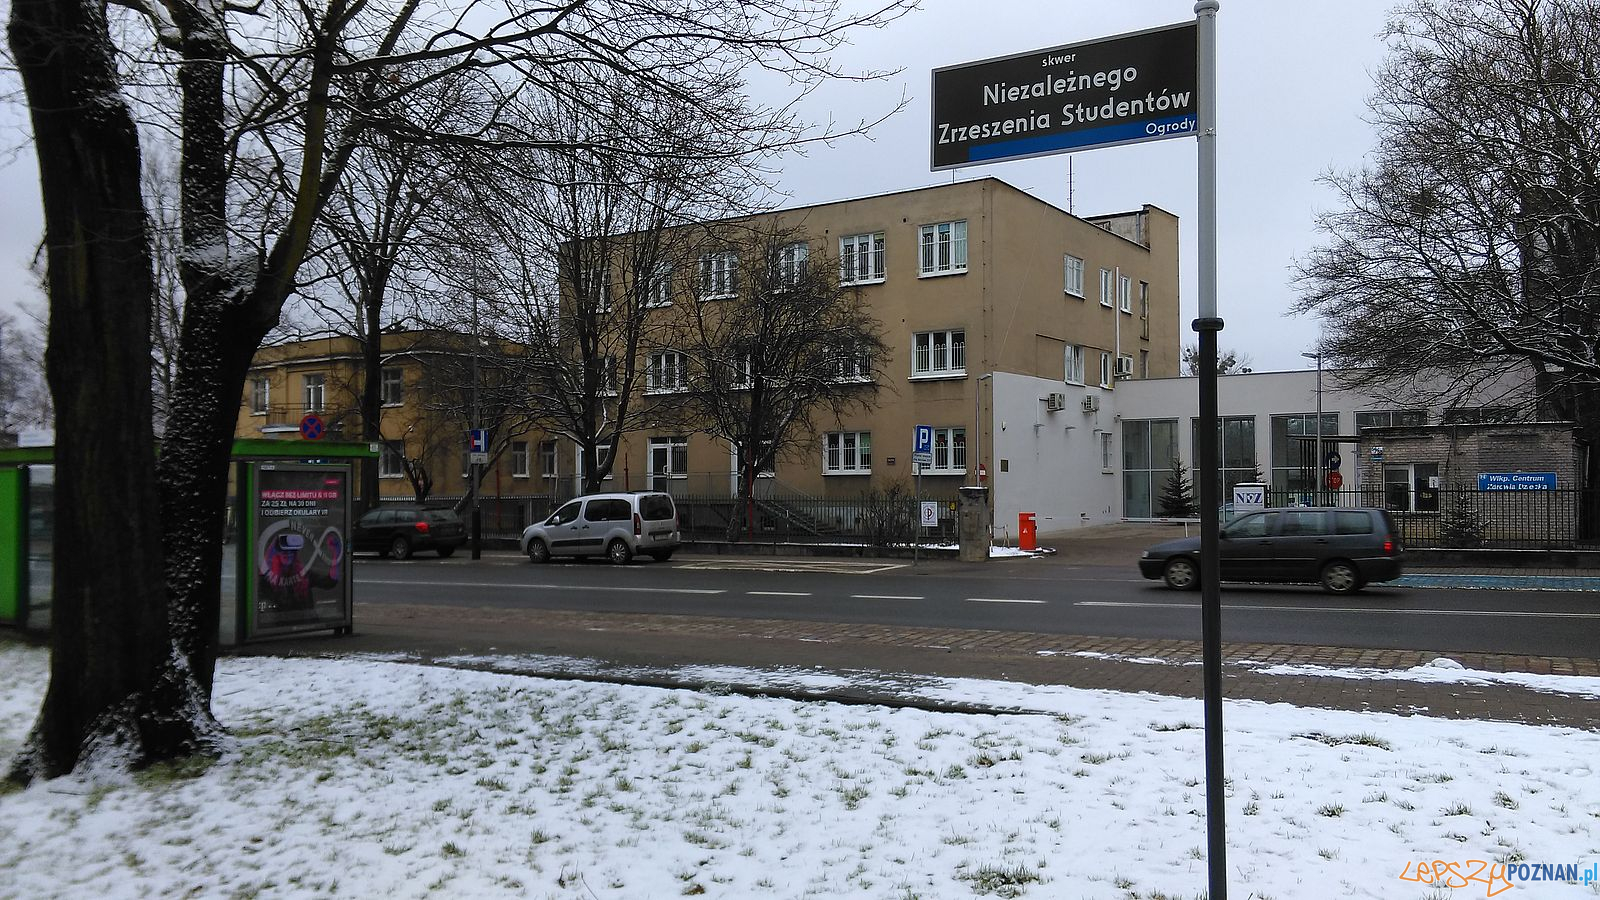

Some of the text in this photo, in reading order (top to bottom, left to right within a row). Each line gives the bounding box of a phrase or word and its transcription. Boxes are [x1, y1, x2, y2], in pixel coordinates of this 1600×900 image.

[1042, 53, 1076, 67] skwer
[983, 66, 1138, 106] Niezależnego
[938, 88, 1191, 145] Zrzeszenia Studentów
[1145, 117, 1196, 136] Ogrody
[920, 429, 928, 448] P
[1489, 475, 1510, 483] Wlkp.
